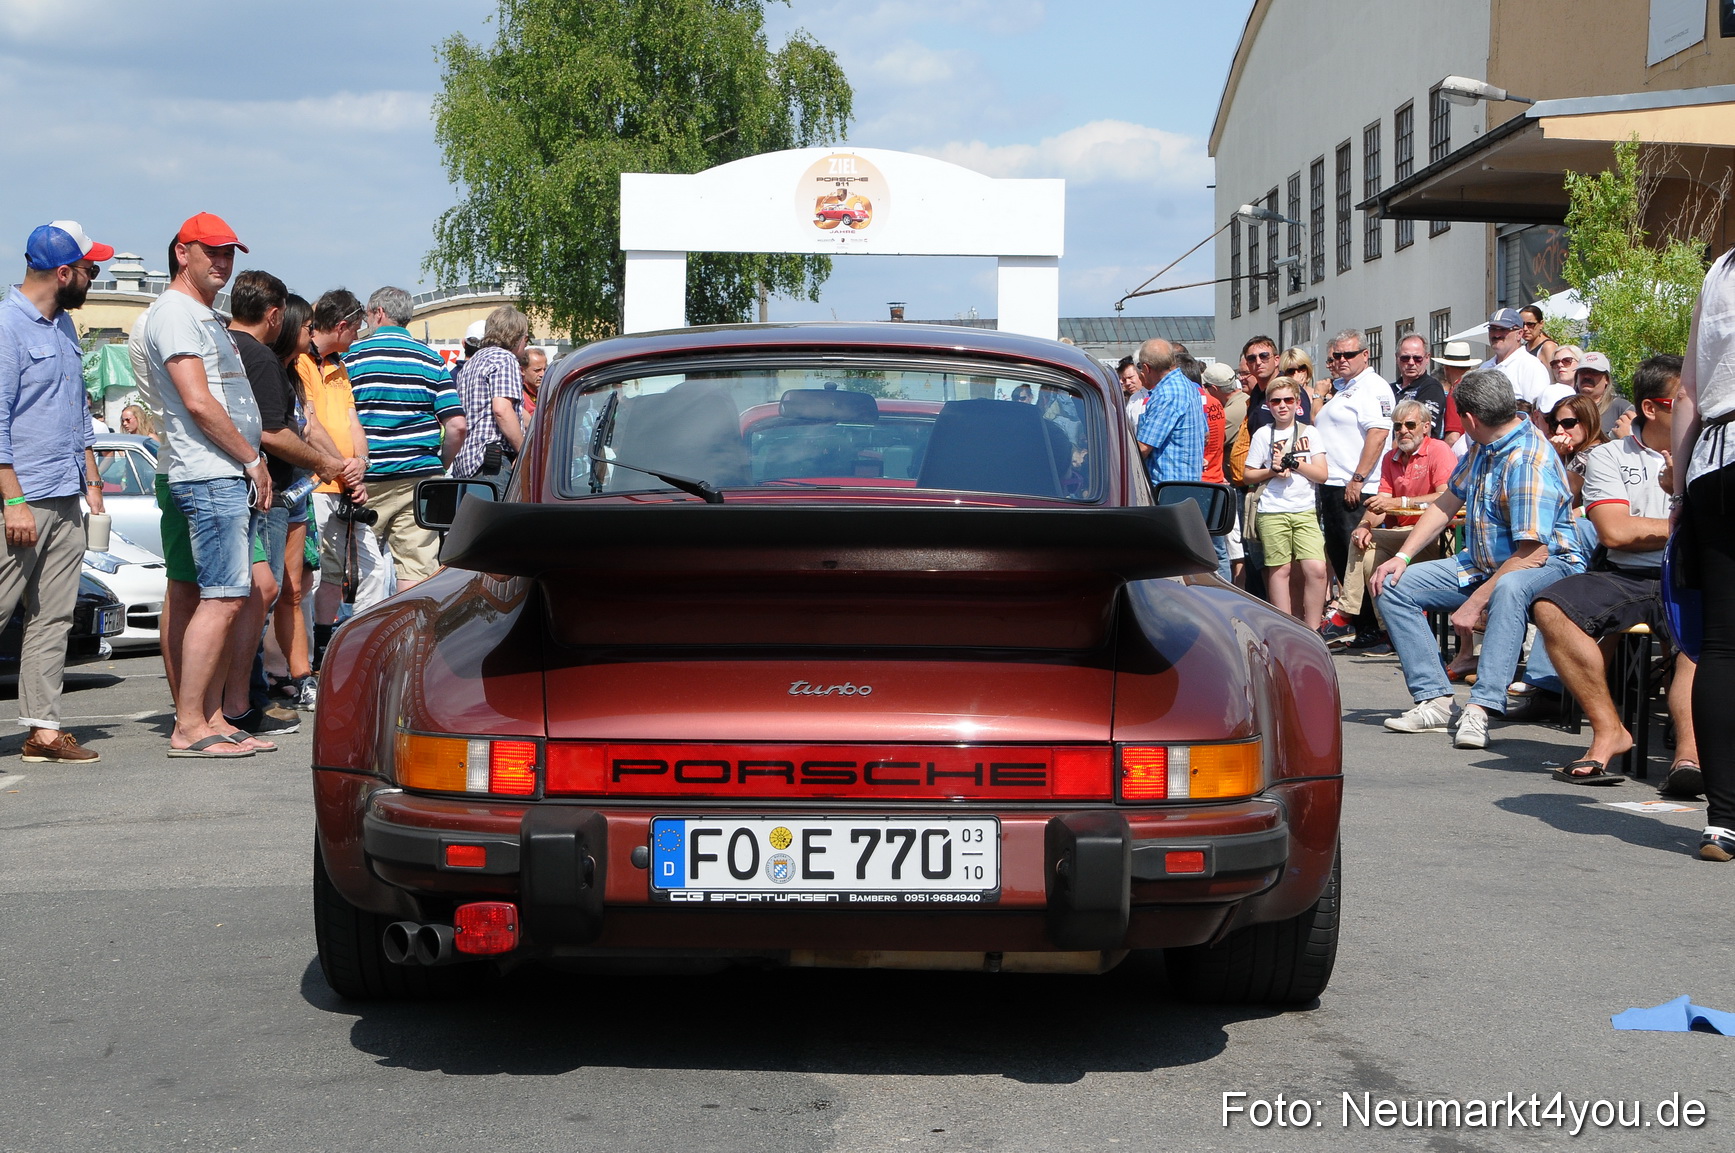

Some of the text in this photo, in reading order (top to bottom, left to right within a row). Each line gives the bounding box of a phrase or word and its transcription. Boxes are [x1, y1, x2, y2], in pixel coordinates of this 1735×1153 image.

[828, 158, 857, 174] ZIEL
[1620, 465, 1648, 485] 351
[788, 680, 872, 695] turbo
[612, 759, 1046, 787] PORSCHE
[962, 828, 983, 843] 03
[690, 828, 760, 881] FO
[850, 828, 952, 880] 770
[663, 861, 675, 876] D
[963, 866, 984, 880] 10
[670, 891, 981, 902] CG SPORTWAGEN BAMBERG 0951-9684940
